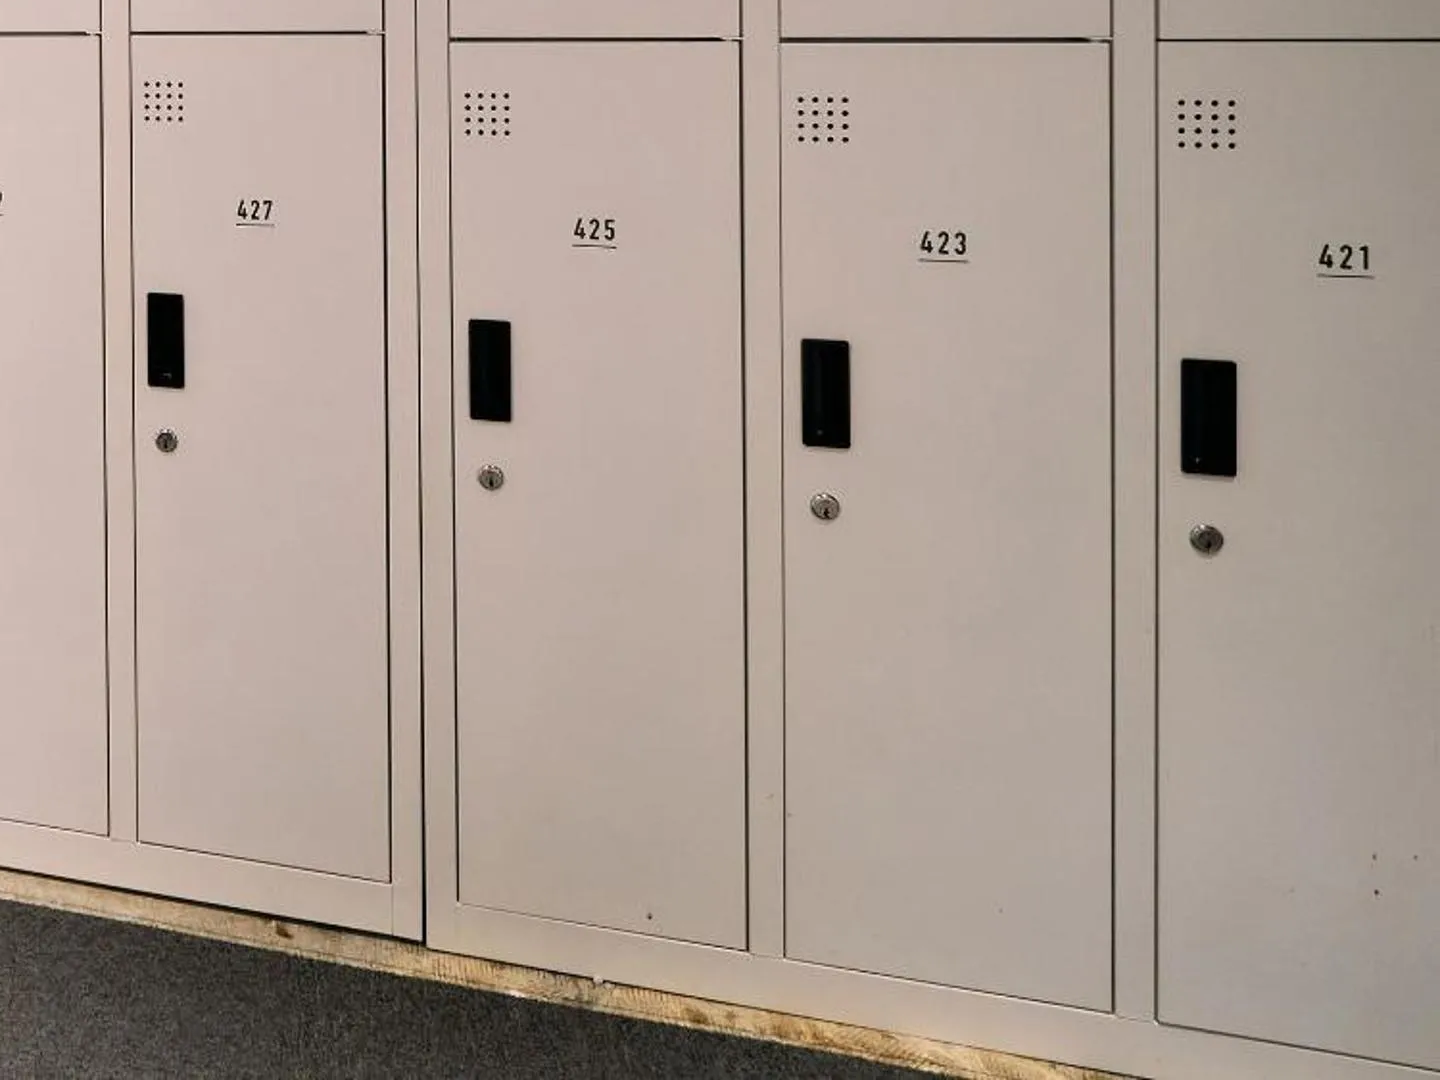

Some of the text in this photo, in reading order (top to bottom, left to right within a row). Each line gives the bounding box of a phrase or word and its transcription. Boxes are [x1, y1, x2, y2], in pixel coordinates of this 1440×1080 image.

[237, 199, 274, 221] 427
[573, 218, 615, 241] 425
[920, 231, 967, 256] 423
[1318, 244, 1369, 270] 421
